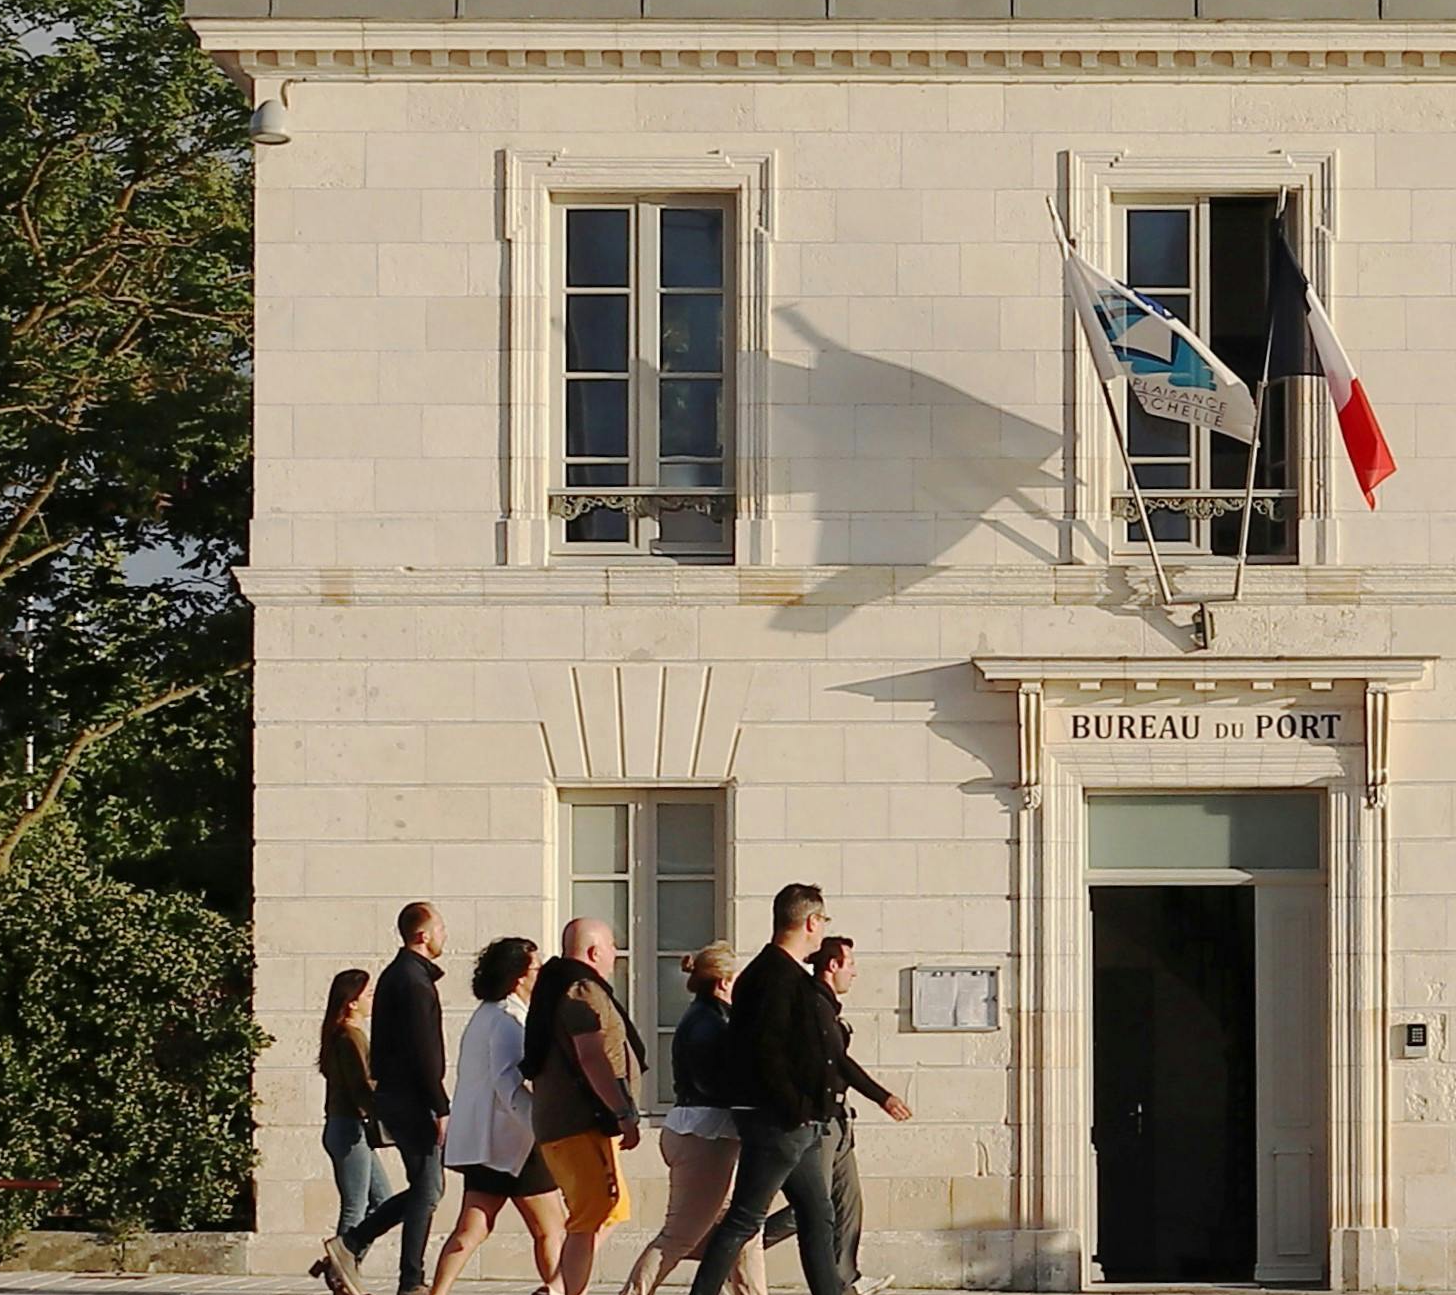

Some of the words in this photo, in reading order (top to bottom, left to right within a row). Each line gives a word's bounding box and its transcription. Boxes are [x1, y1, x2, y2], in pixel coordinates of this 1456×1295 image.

[1133, 377, 1228, 412] PLAISANCE
[1071, 714, 1201, 740] BUREAU
[1215, 722, 1244, 740] DU
[1255, 714, 1342, 740] PORT
